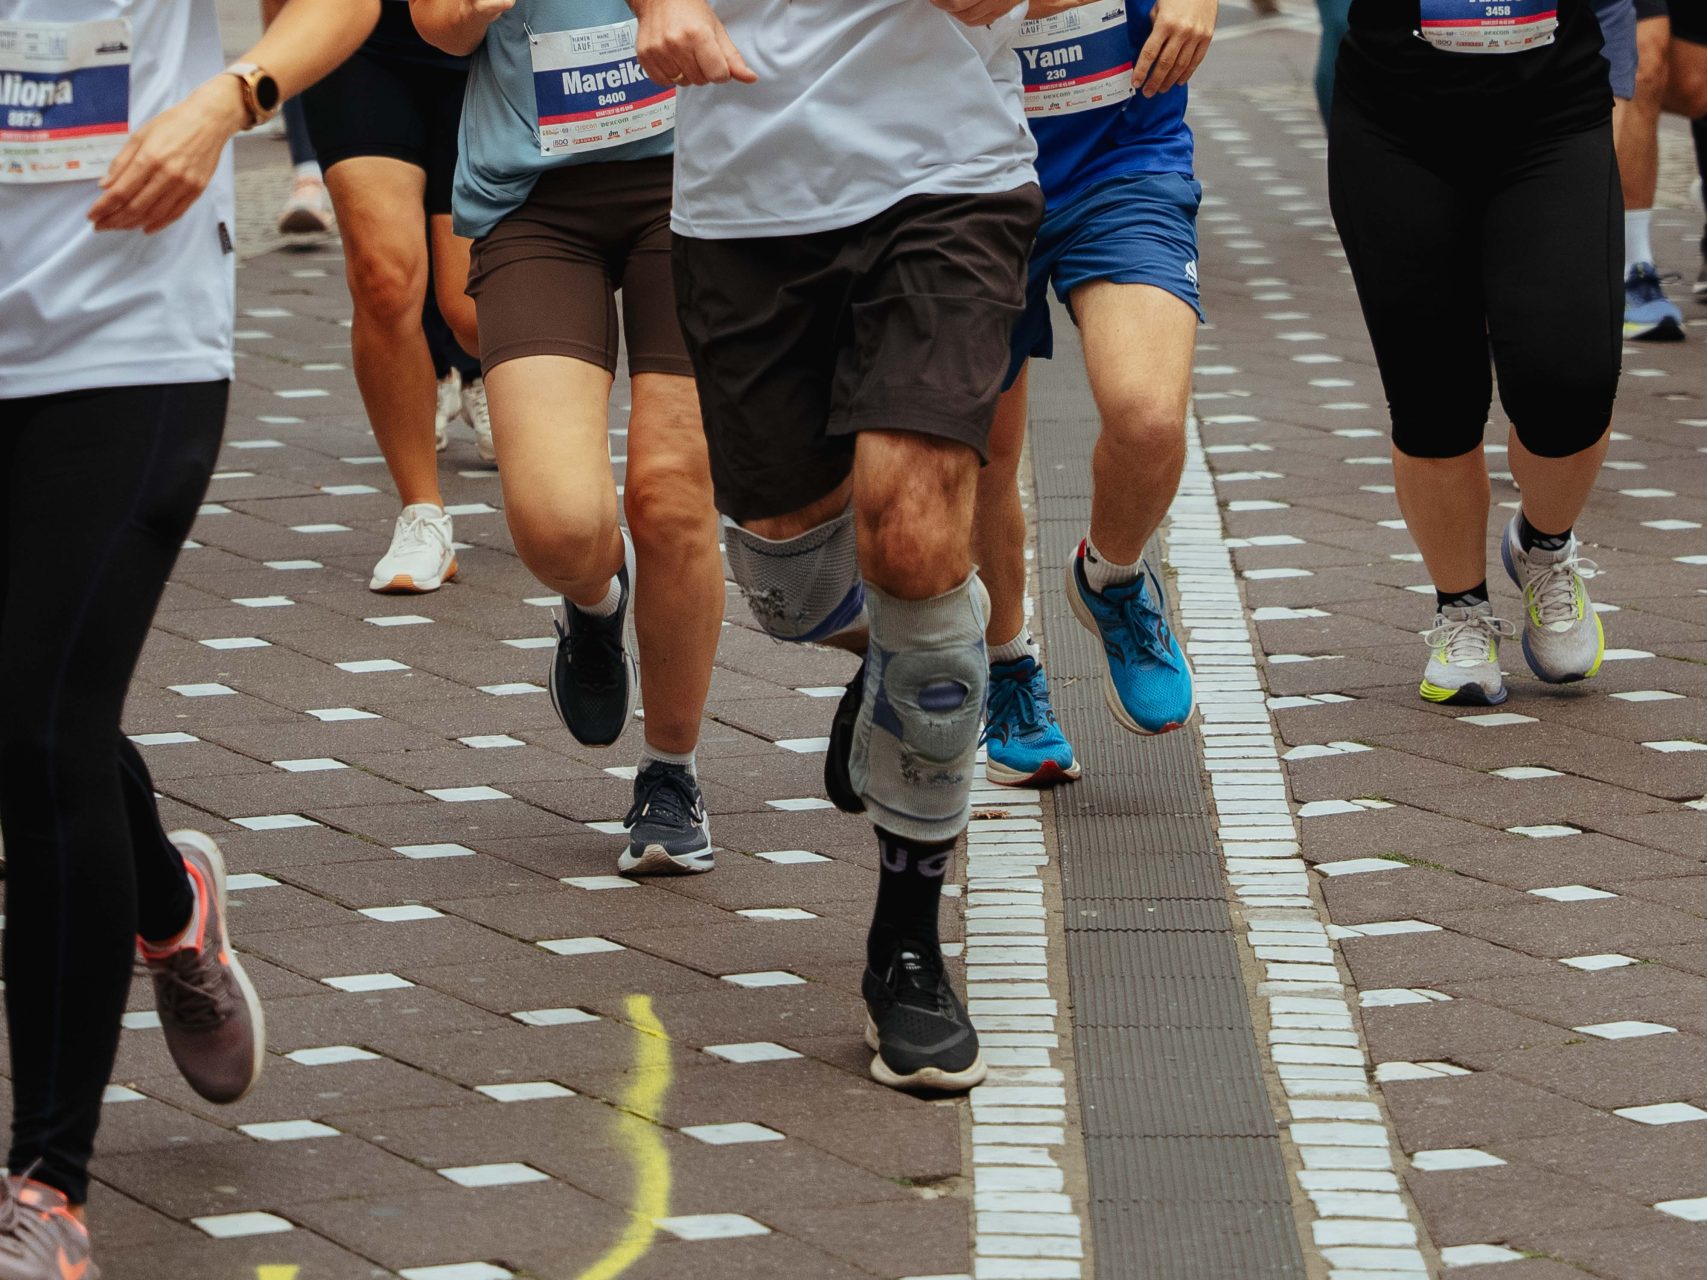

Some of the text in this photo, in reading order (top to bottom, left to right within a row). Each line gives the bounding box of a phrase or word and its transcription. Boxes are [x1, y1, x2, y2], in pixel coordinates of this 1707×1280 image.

[1485, 6, 1511, 16] 3458
[1021, 24, 1040, 35] LAUF
[574, 42, 591, 52] LAUF
[1023, 44, 1083, 70] Yann
[1046, 69, 1067, 81] 230
[597, 91, 626, 106] 8400
